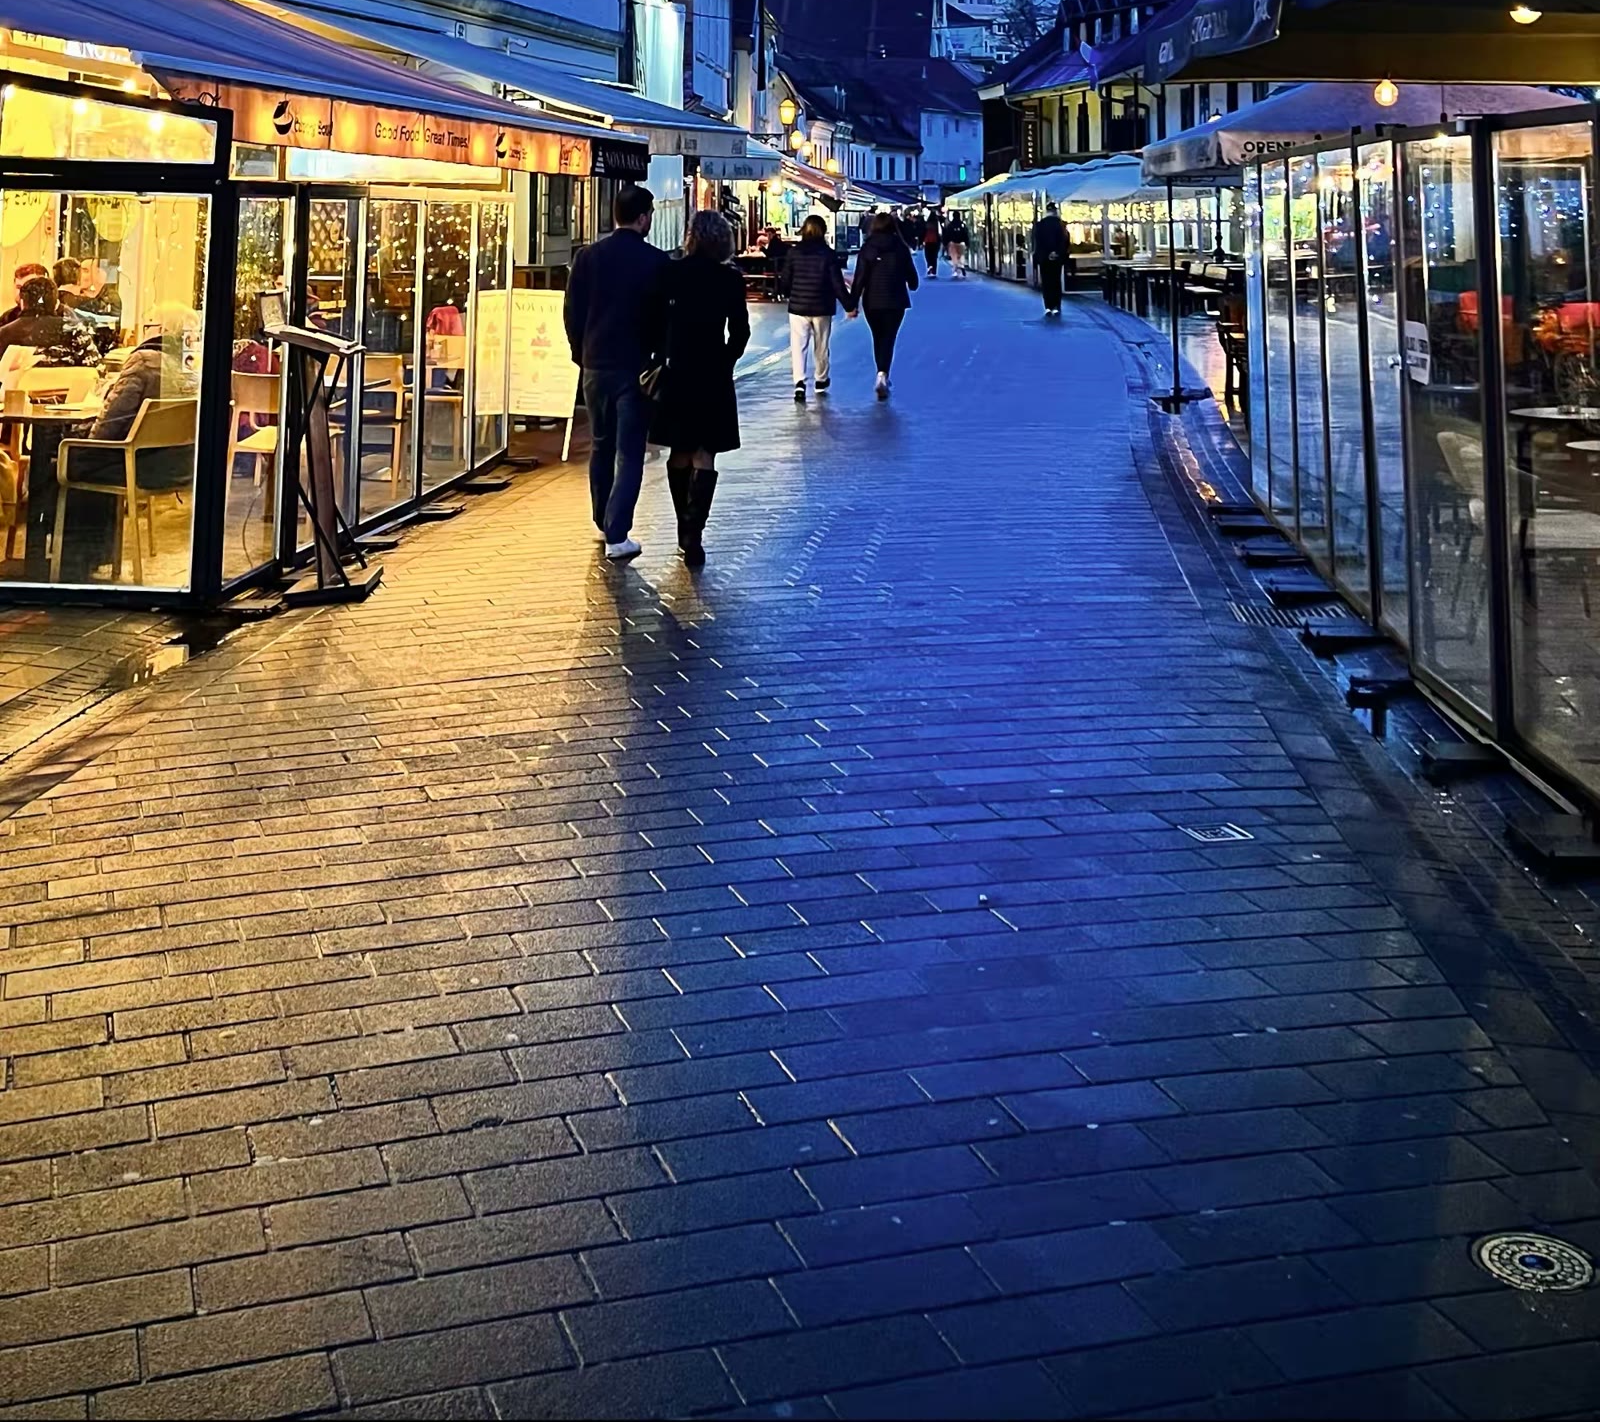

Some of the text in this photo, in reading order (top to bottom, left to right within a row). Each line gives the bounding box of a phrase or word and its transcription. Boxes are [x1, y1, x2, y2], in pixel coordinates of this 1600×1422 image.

[375, 121, 398, 140] Good
[400, 125, 420, 142] Food
[425, 128, 445, 146] Great
